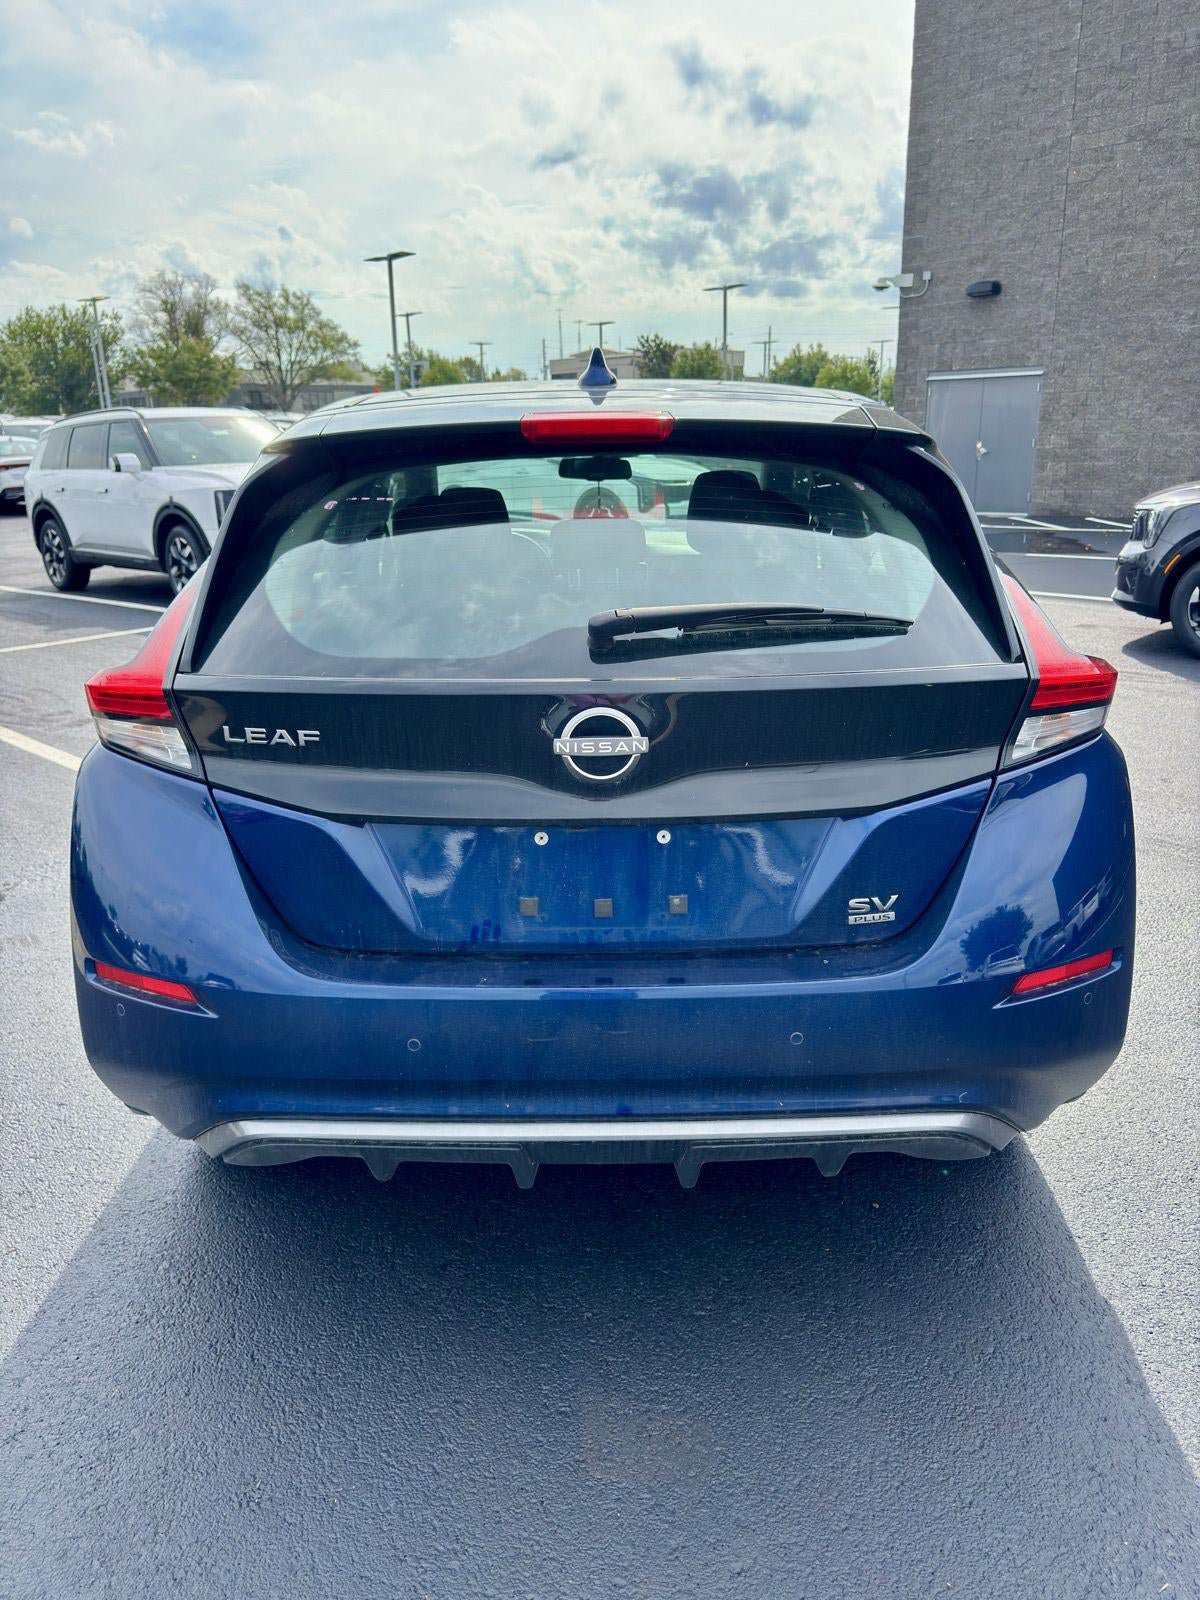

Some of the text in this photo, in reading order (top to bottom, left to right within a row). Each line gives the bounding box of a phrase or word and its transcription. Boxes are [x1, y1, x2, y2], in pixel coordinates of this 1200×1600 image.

[222, 725, 321, 747] LEAF
[555, 740, 647, 754] NISSAN
[847, 894, 899, 913] SV
[853, 913, 892, 923] PLUS
